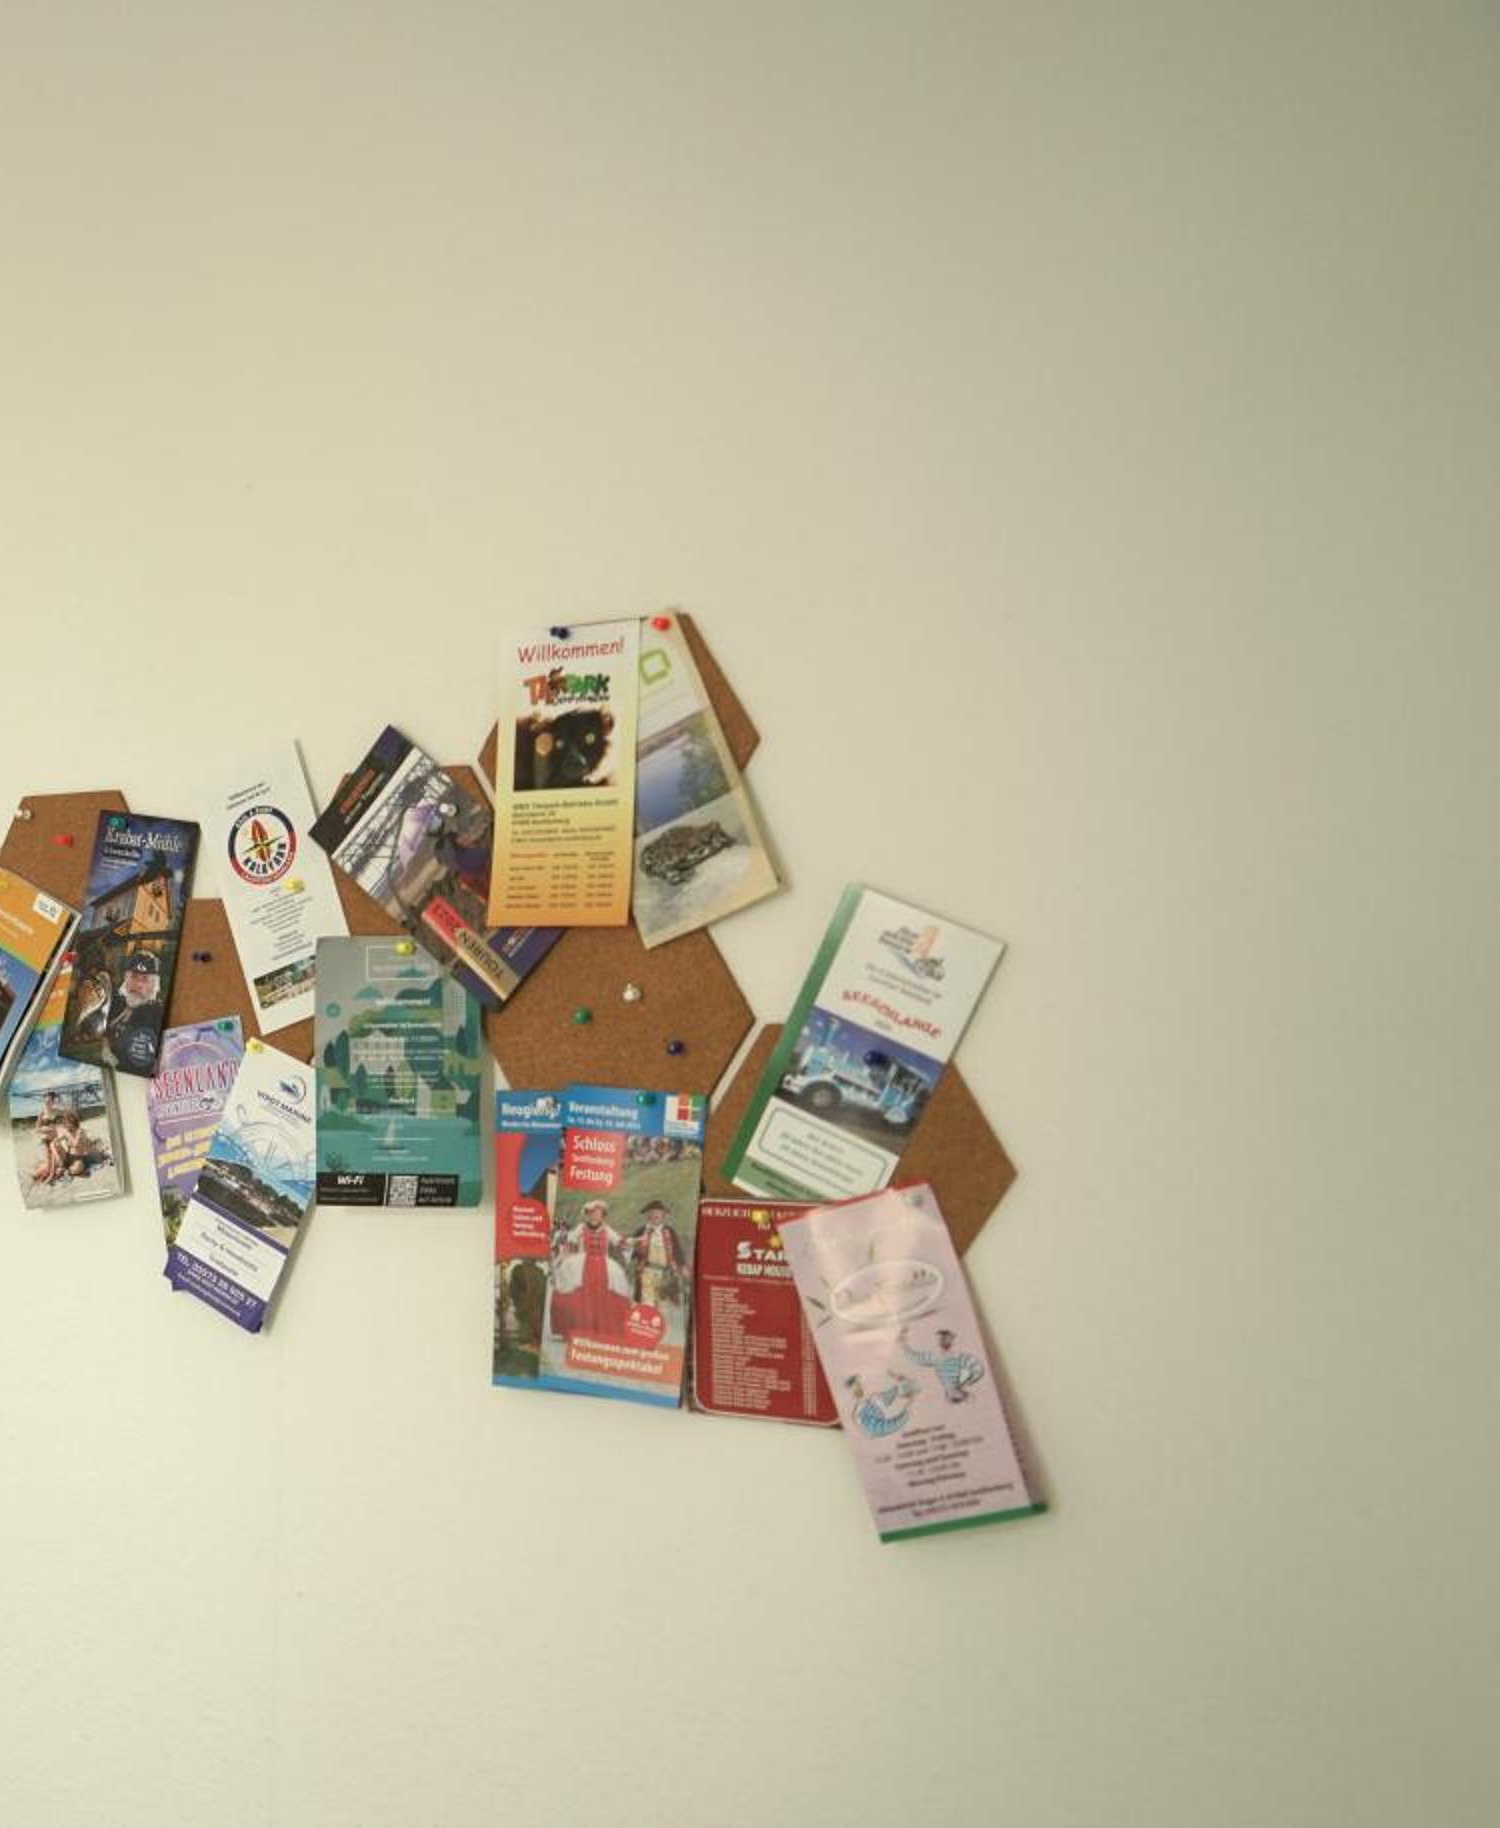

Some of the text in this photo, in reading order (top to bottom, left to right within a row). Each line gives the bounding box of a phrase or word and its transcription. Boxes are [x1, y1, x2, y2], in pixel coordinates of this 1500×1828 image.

[517, 637, 625, 663] Willkommen!
[572, 1135, 616, 1154] Schloss
[569, 1165, 613, 1185] Festung
